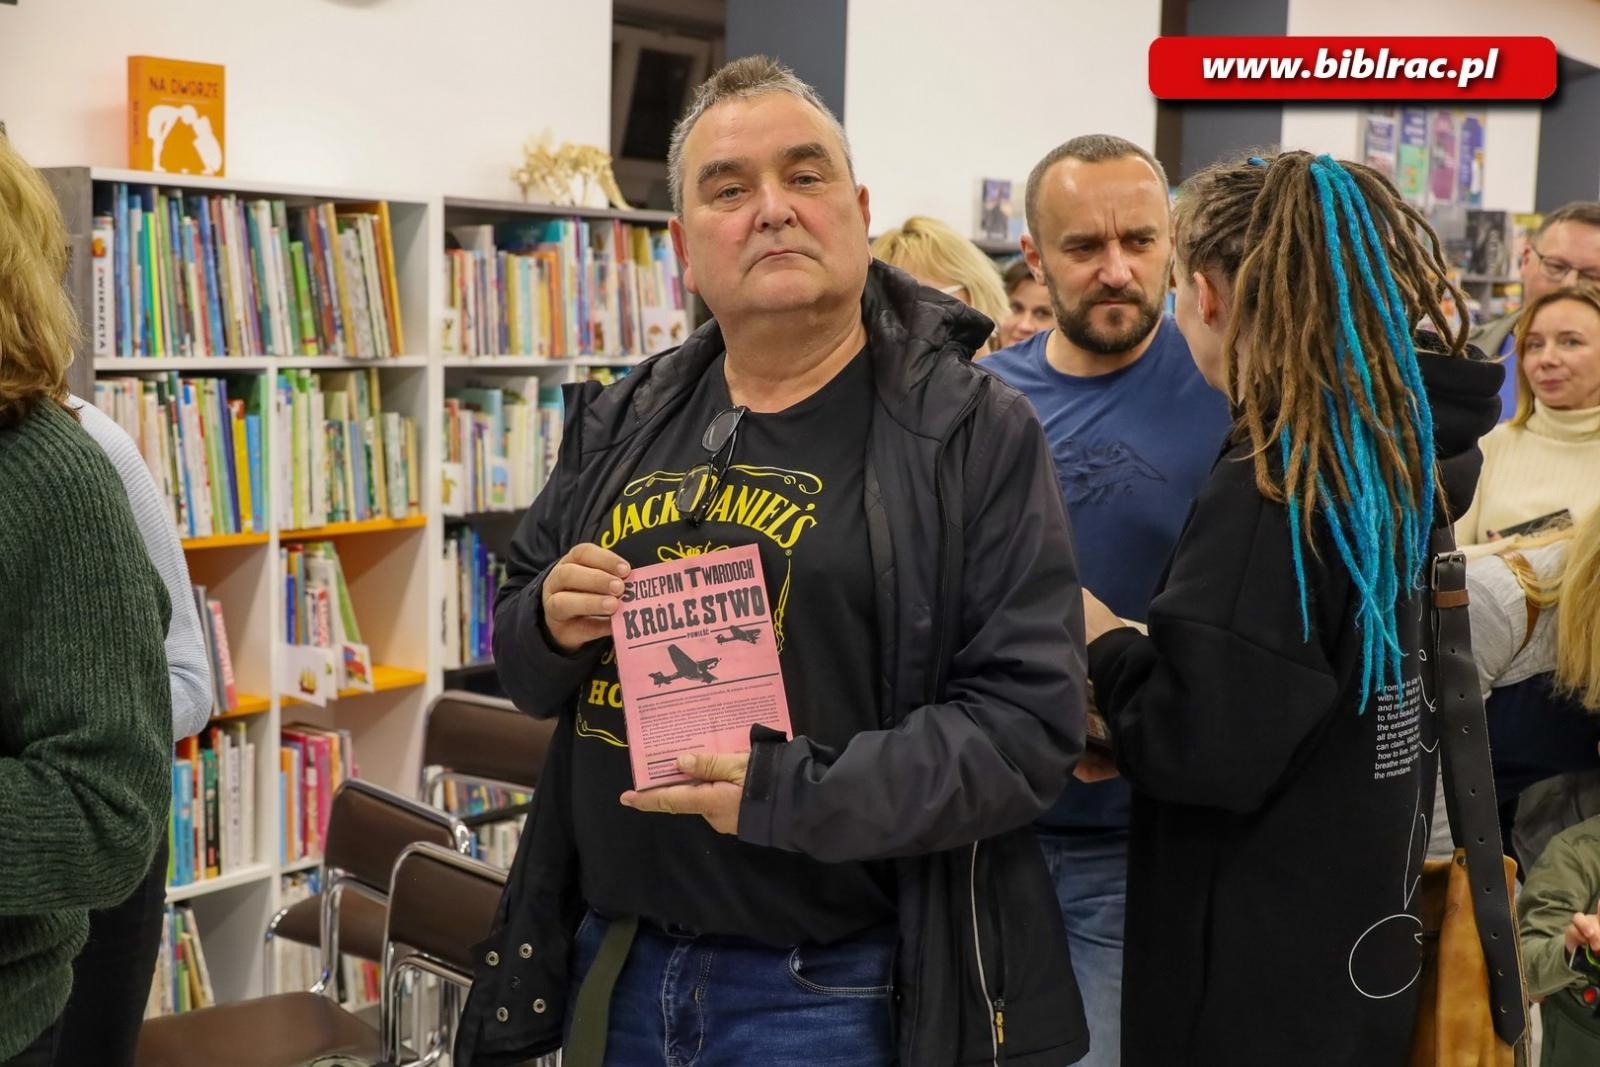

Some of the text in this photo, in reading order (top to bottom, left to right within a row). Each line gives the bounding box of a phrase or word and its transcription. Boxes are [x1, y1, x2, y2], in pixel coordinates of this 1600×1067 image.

[149, 76, 166, 91] NA
[601, 490, 681, 549] JACK
[622, 558, 755, 603] SZCZEPAN TWARDOCH
[623, 585, 766, 640] KRÓLESTWO
[1377, 694, 1394, 702] with
[1377, 704, 1392, 712] and
[1377, 714, 1385, 722] to
[1376, 733, 1386, 741] all
[1375, 759, 1398, 770] breathe
[1374, 771, 1385, 779] the
